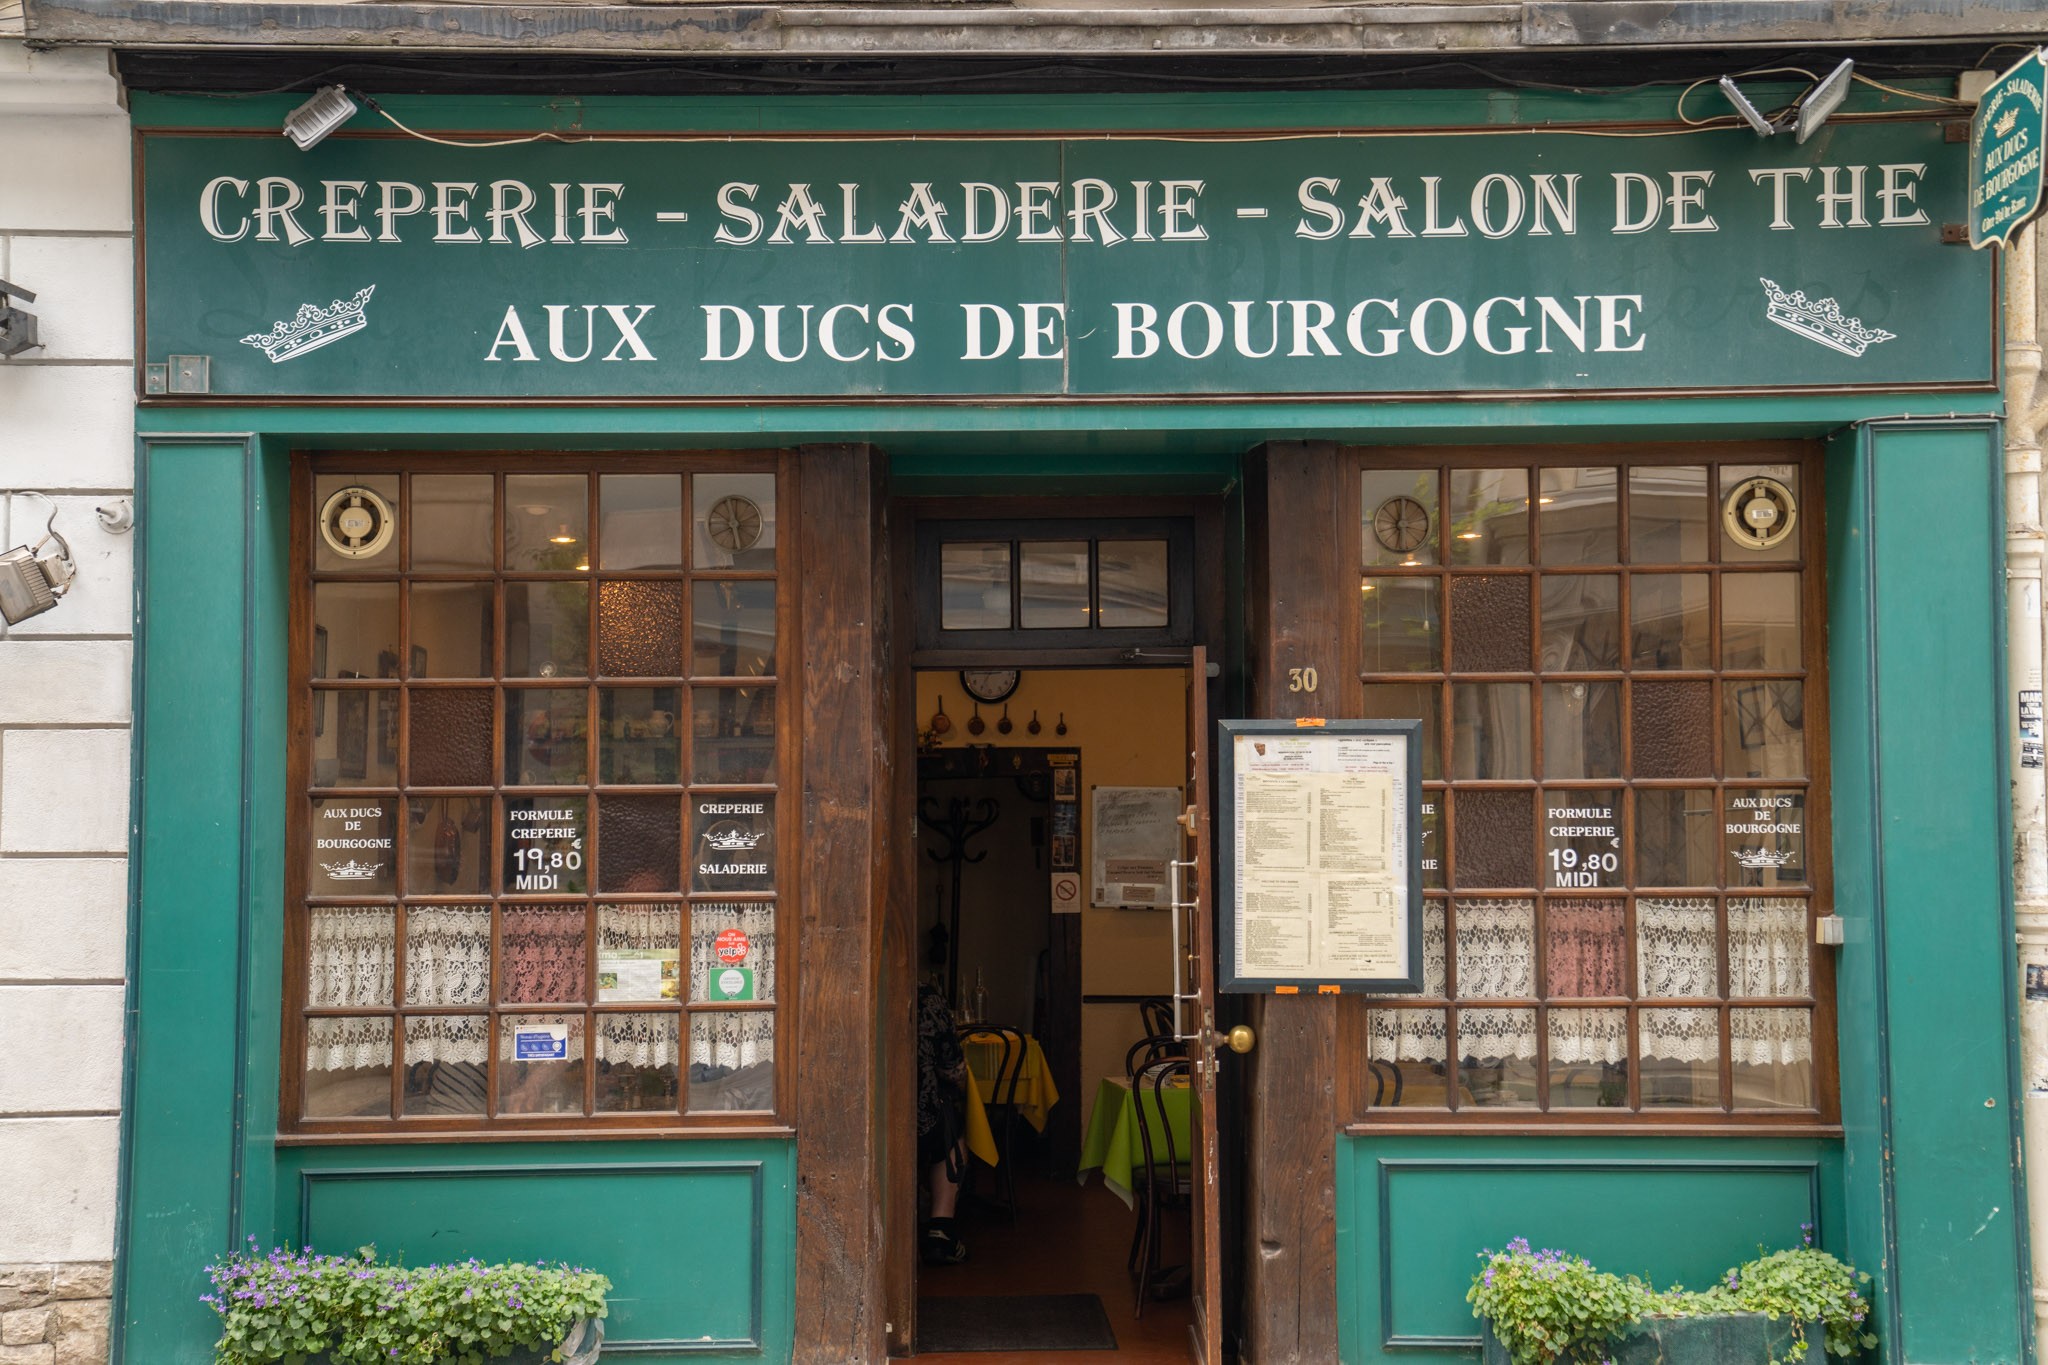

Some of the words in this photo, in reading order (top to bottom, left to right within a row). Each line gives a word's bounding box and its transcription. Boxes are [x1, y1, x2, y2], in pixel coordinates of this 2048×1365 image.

[1985, 145, 2004, 175] AUX
[2003, 127, 2028, 161] DUCS
[1973, 183, 1986, 210] DE
[1985, 146, 2041, 201] BOURGOGNE
[200, 177, 629, 249] CREPERIE
[714, 179, 1209, 247] SALADERIE
[1295, 173, 1582, 241] SALON
[1611, 170, 1719, 235] DE
[1749, 163, 1931, 231] THE
[484, 304, 656, 363] AUX
[700, 304, 914, 363] DUCS
[960, 303, 1065, 361] DE
[1112, 295, 1646, 360] BOURGOGNE
[1288, 667, 1318, 693] 30
[699, 803, 764, 814] CREPERIE
[1732, 798, 1758, 809] AUX
[1759, 797, 1792, 808] DUCS
[323, 807, 348, 819] AUX
[350, 806, 382, 819] DUCS
[510, 809, 574, 821] FORMULE
[1548, 808, 1612, 819] FORMULE
[1754, 810, 1772, 821] DE
[344, 820, 362, 831] DE
[1549, 826, 1615, 837] CREPERIE
[1725, 823, 1801, 834] BOURGOGNE
[511, 827, 576, 839] CREPERIE
[316, 838, 392, 849] BOURGOGNE
[698, 863, 768, 875] SALADERIE
[516, 874, 558, 890] MIDI
[1556, 871, 1598, 887] MIDI
[719, 947, 737, 957] yelp
